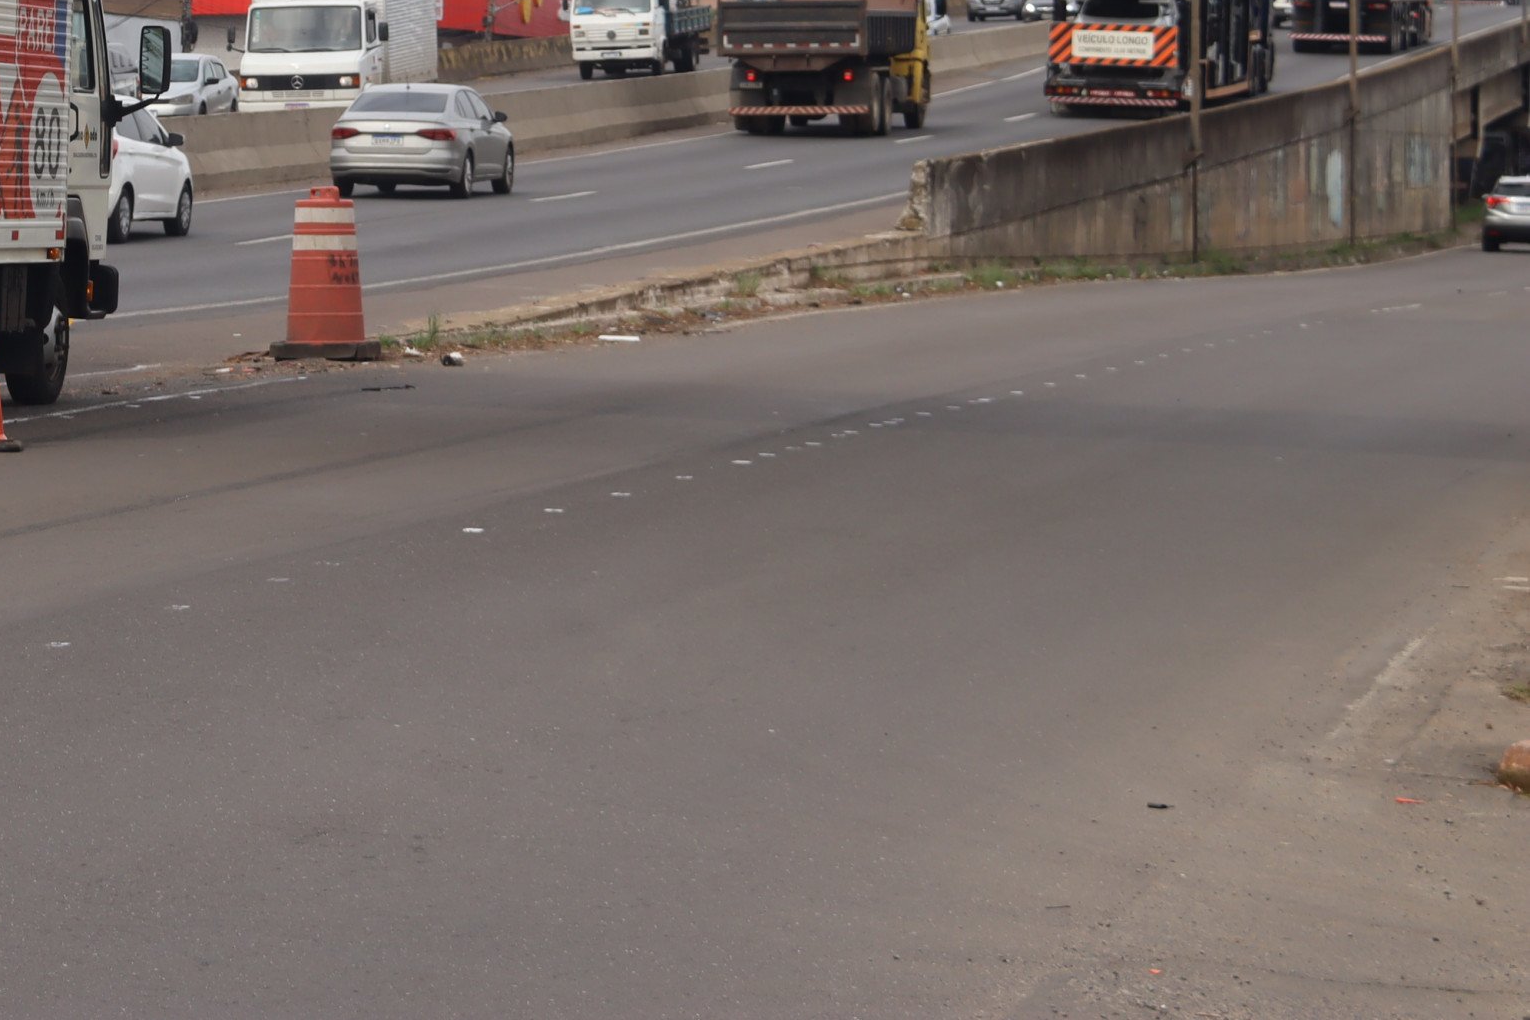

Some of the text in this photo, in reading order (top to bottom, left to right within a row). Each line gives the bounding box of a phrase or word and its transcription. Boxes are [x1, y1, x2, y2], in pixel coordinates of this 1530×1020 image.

[19, 7, 53, 52] PARE
[1076, 33, 1149, 46] VEÍCULO LONGO
[33, 106, 61, 180] 80
